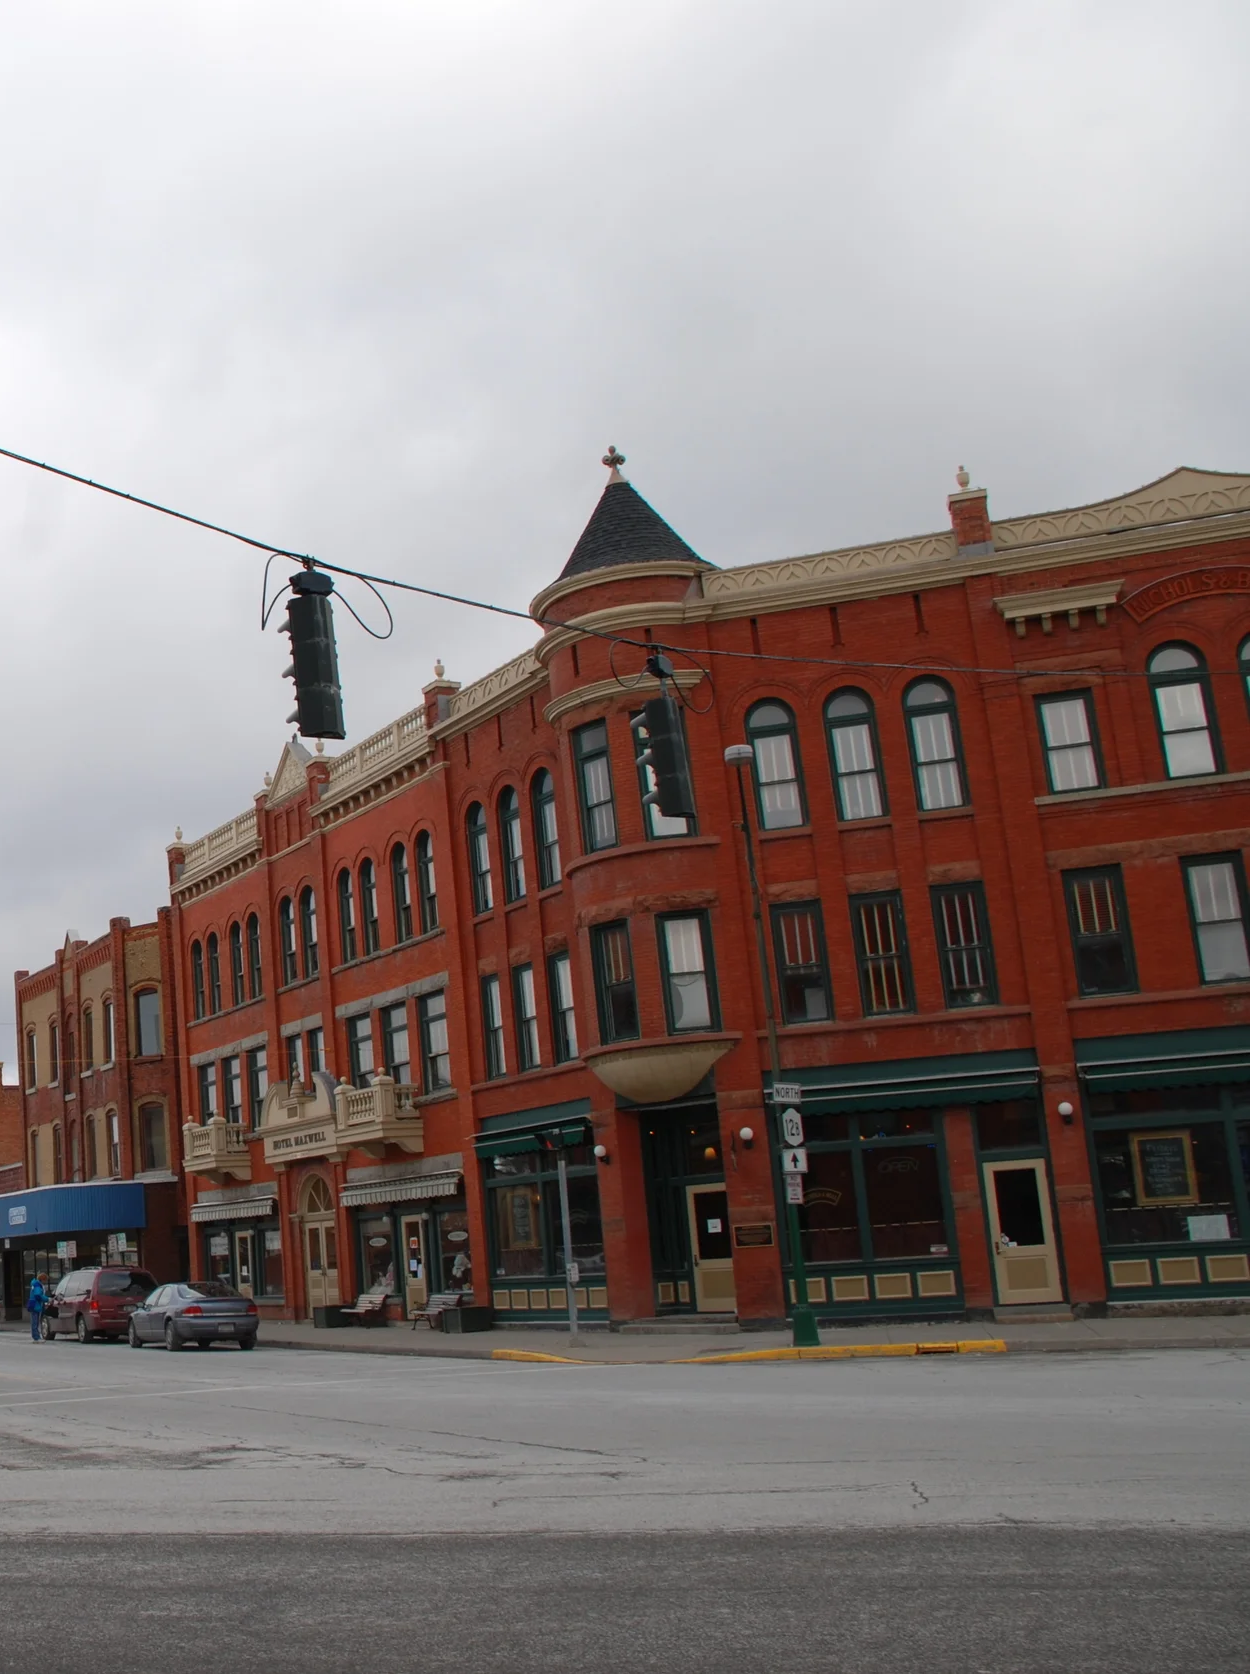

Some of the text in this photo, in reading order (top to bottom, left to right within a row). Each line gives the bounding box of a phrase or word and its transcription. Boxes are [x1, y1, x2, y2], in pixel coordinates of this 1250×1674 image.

[1131, 573, 1215, 614] NICHOLS
[1219, 574, 1231, 589] &
[775, 1086, 800, 1099] NORTH
[785, 1119, 800, 1137] 12B
[273, 1131, 327, 1151] HOTEL MAXWELL
[878, 1160, 919, 1174] OPEN
